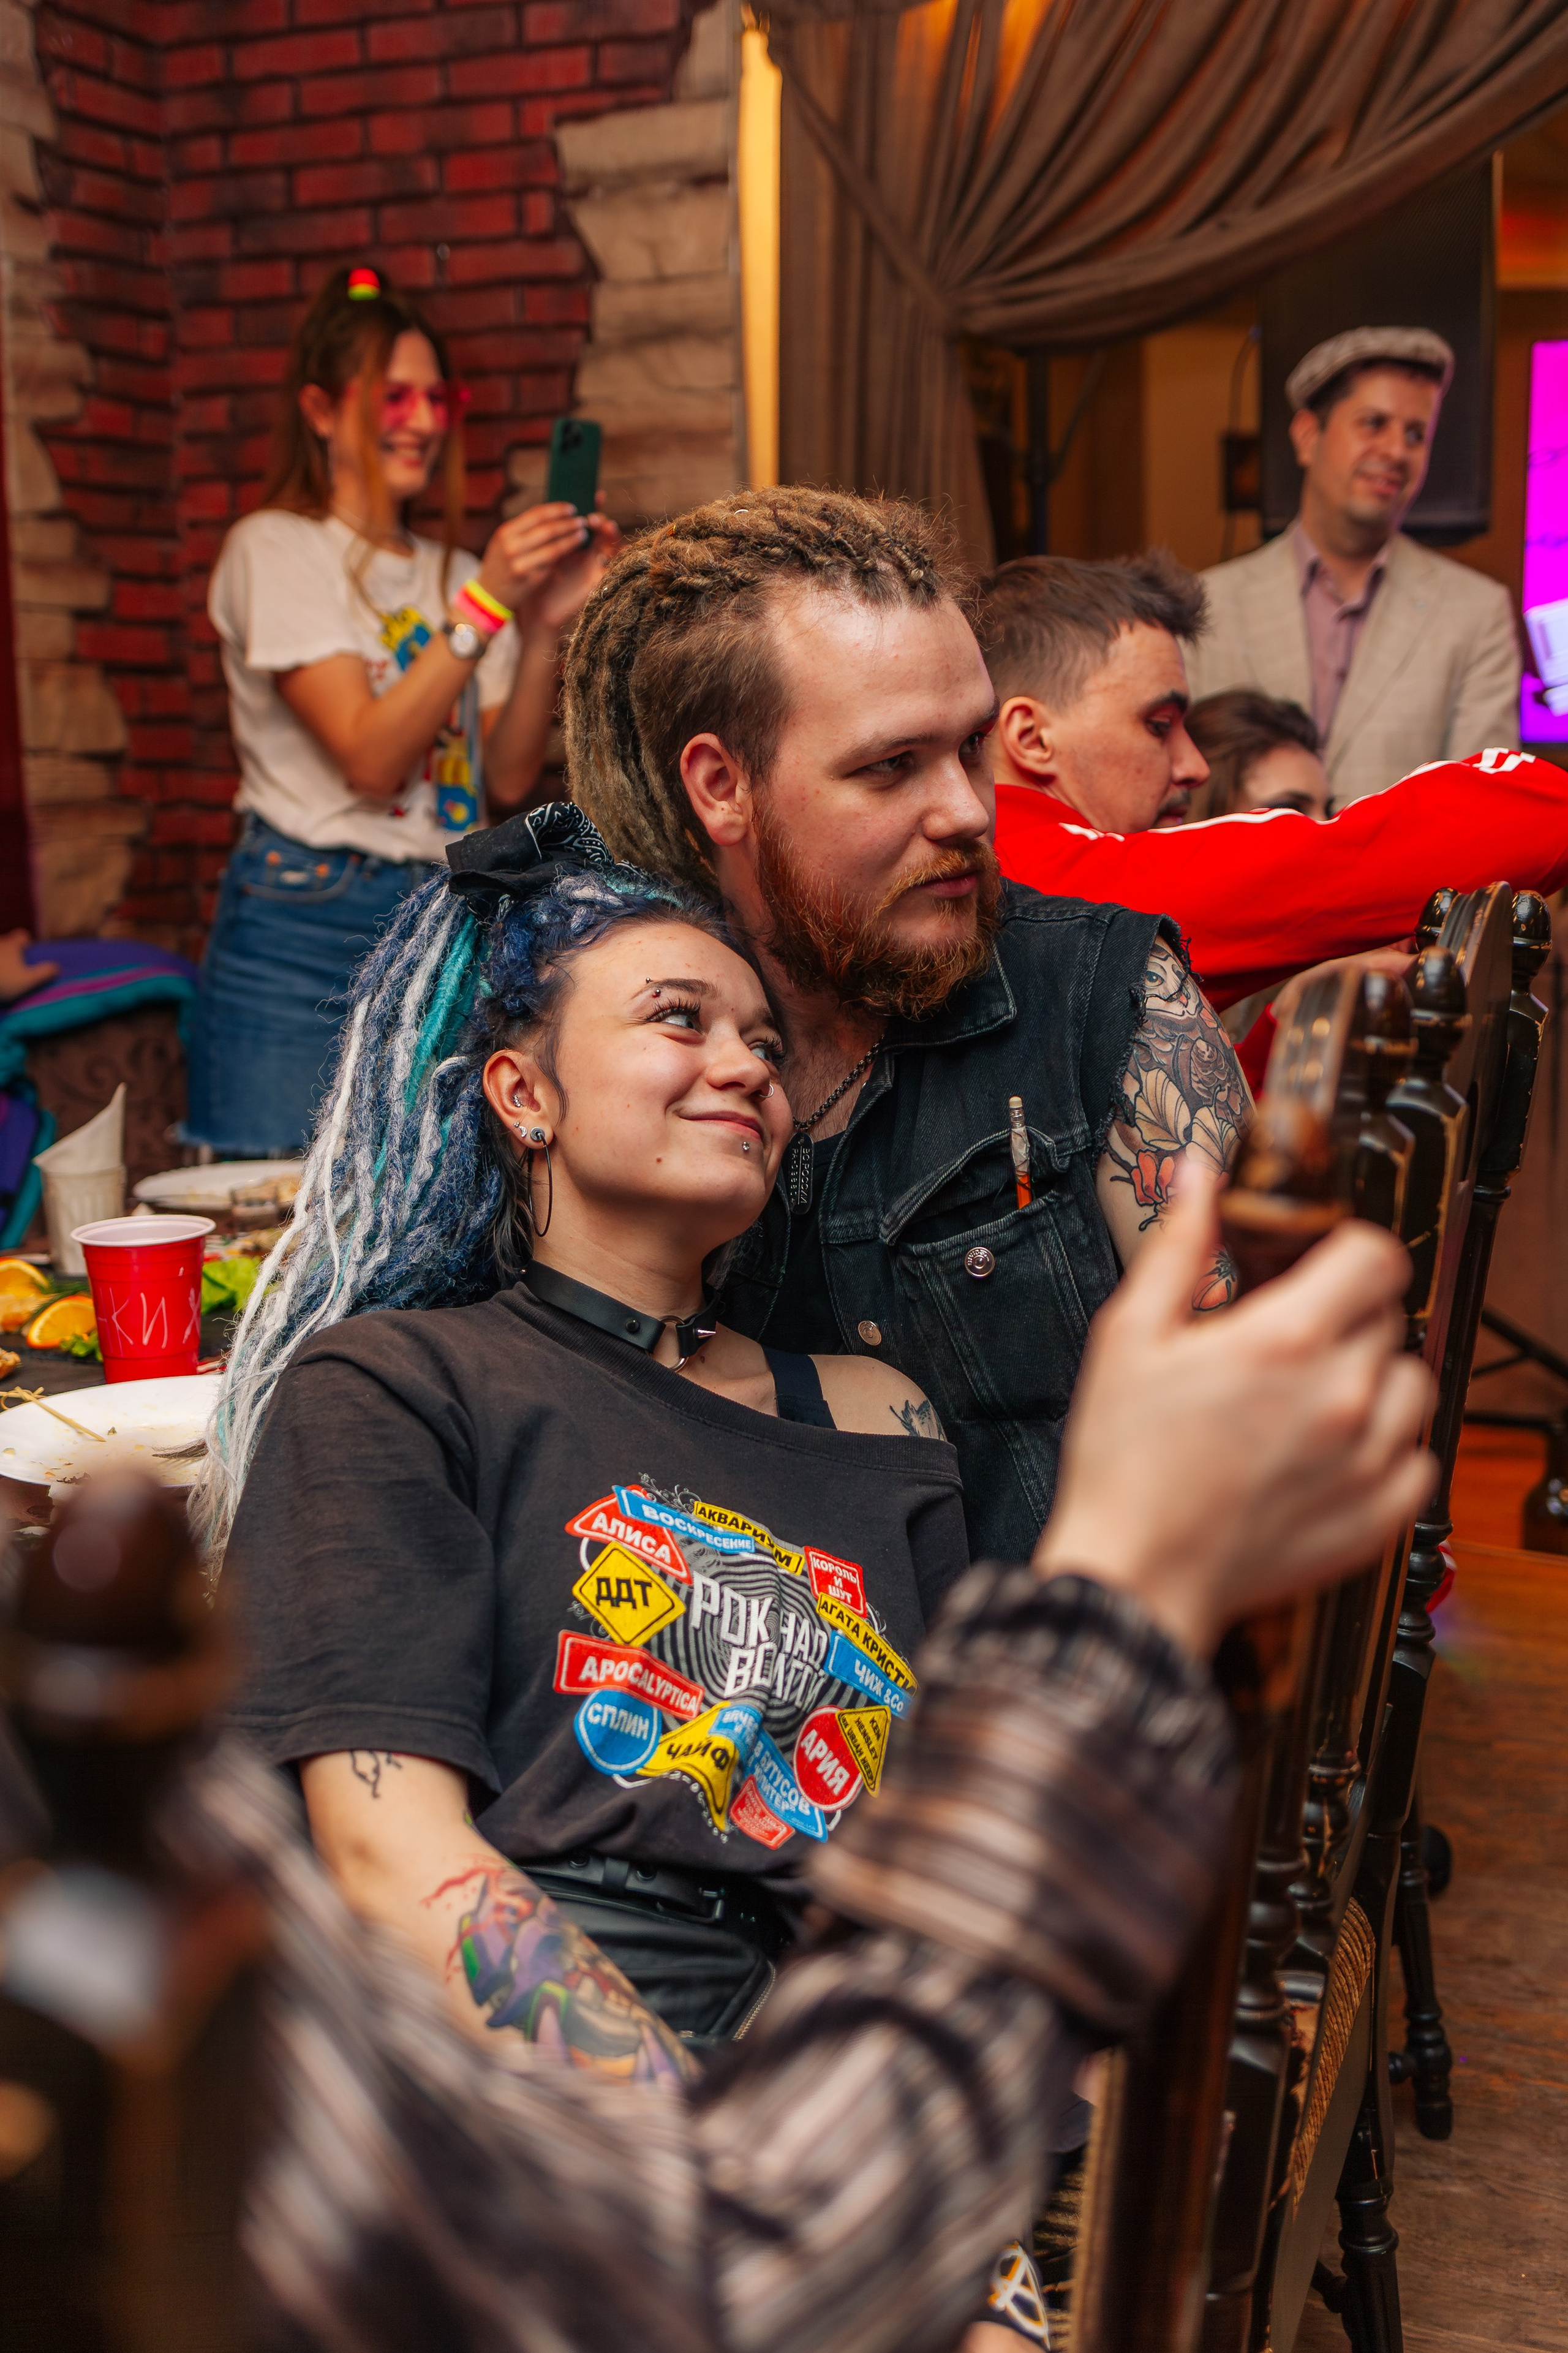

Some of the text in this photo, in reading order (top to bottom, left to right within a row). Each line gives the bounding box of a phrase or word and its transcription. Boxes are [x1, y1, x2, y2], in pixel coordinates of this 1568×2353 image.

[590, 1511, 672, 1564] АЛИСА
[641, 1503, 752, 1550] ВОСКРЕСЕНИЕ
[698, 1506, 792, 1568] АКВАРИУМ
[813, 1556, 857, 1584] КОРОЛЬ
[833, 1575, 843, 1588] И
[595, 1577, 652, 1611] ДДТ
[691, 1571, 774, 1647] РОК
[828, 1584, 853, 1604] ШУТ
[821, 1600, 860, 1639] АГАТА
[779, 1612, 828, 1671] НАД
[579, 1655, 697, 1712] APOCALYPTICA
[854, 1659, 884, 1697] ЧИЖ
[587, 1702, 649, 1740] СПЛИН
[854, 1716, 878, 1761] HENSLEY
[869, 1717, 881, 1742] KEN
[800, 1728, 850, 1796] АРИЯ
